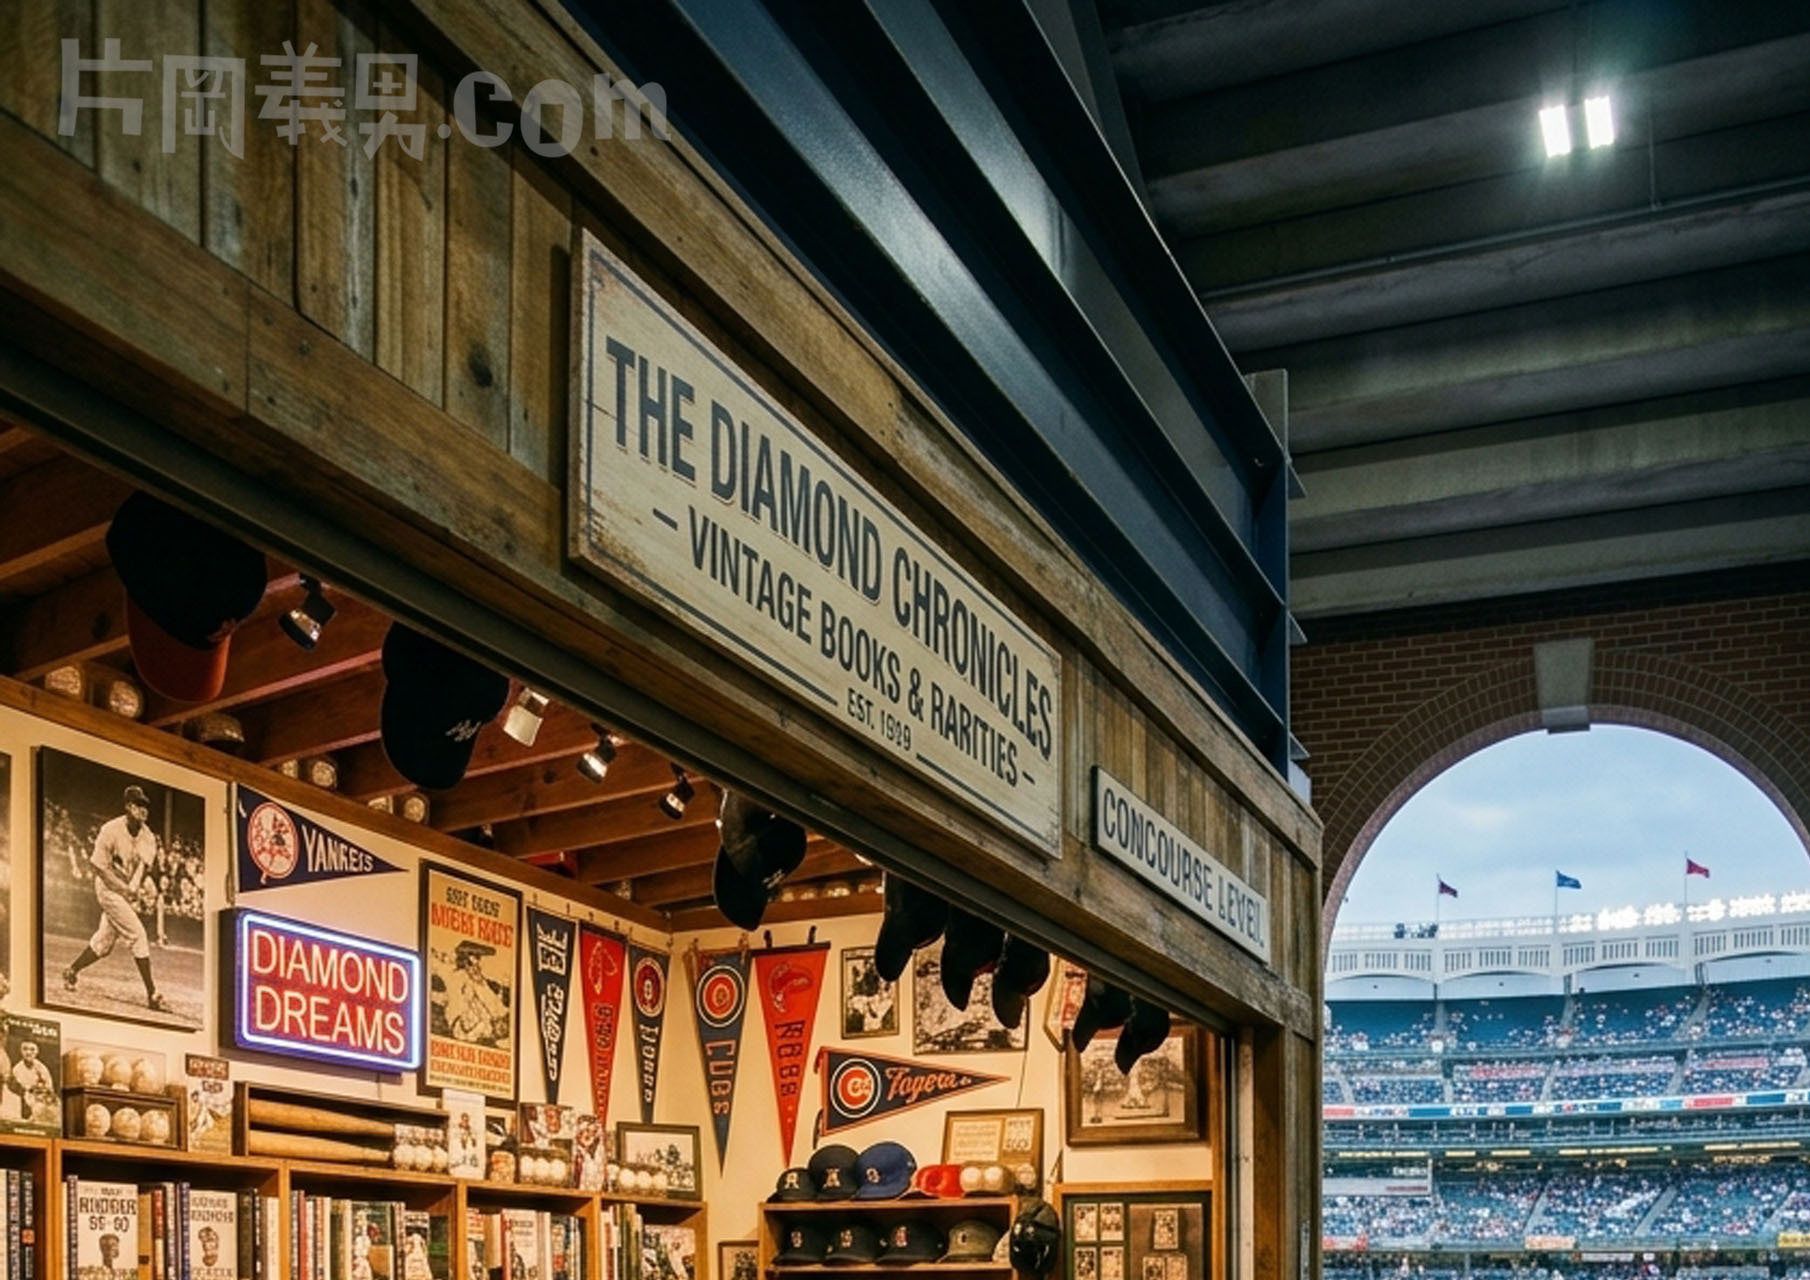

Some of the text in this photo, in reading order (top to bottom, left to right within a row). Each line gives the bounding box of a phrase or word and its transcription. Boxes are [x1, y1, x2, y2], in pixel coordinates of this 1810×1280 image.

[606, 335, 1052, 762] THE DIAMOND CHRONICLES
[687, 505, 1019, 788] VINTAGE BOOKS & RARITIES
[847, 687, 876, 731] EST.
[1103, 787, 1213, 911] CONCOURSE
[252, 929, 409, 1004] DIAMOND
[254, 984, 405, 1056] DREAMS
